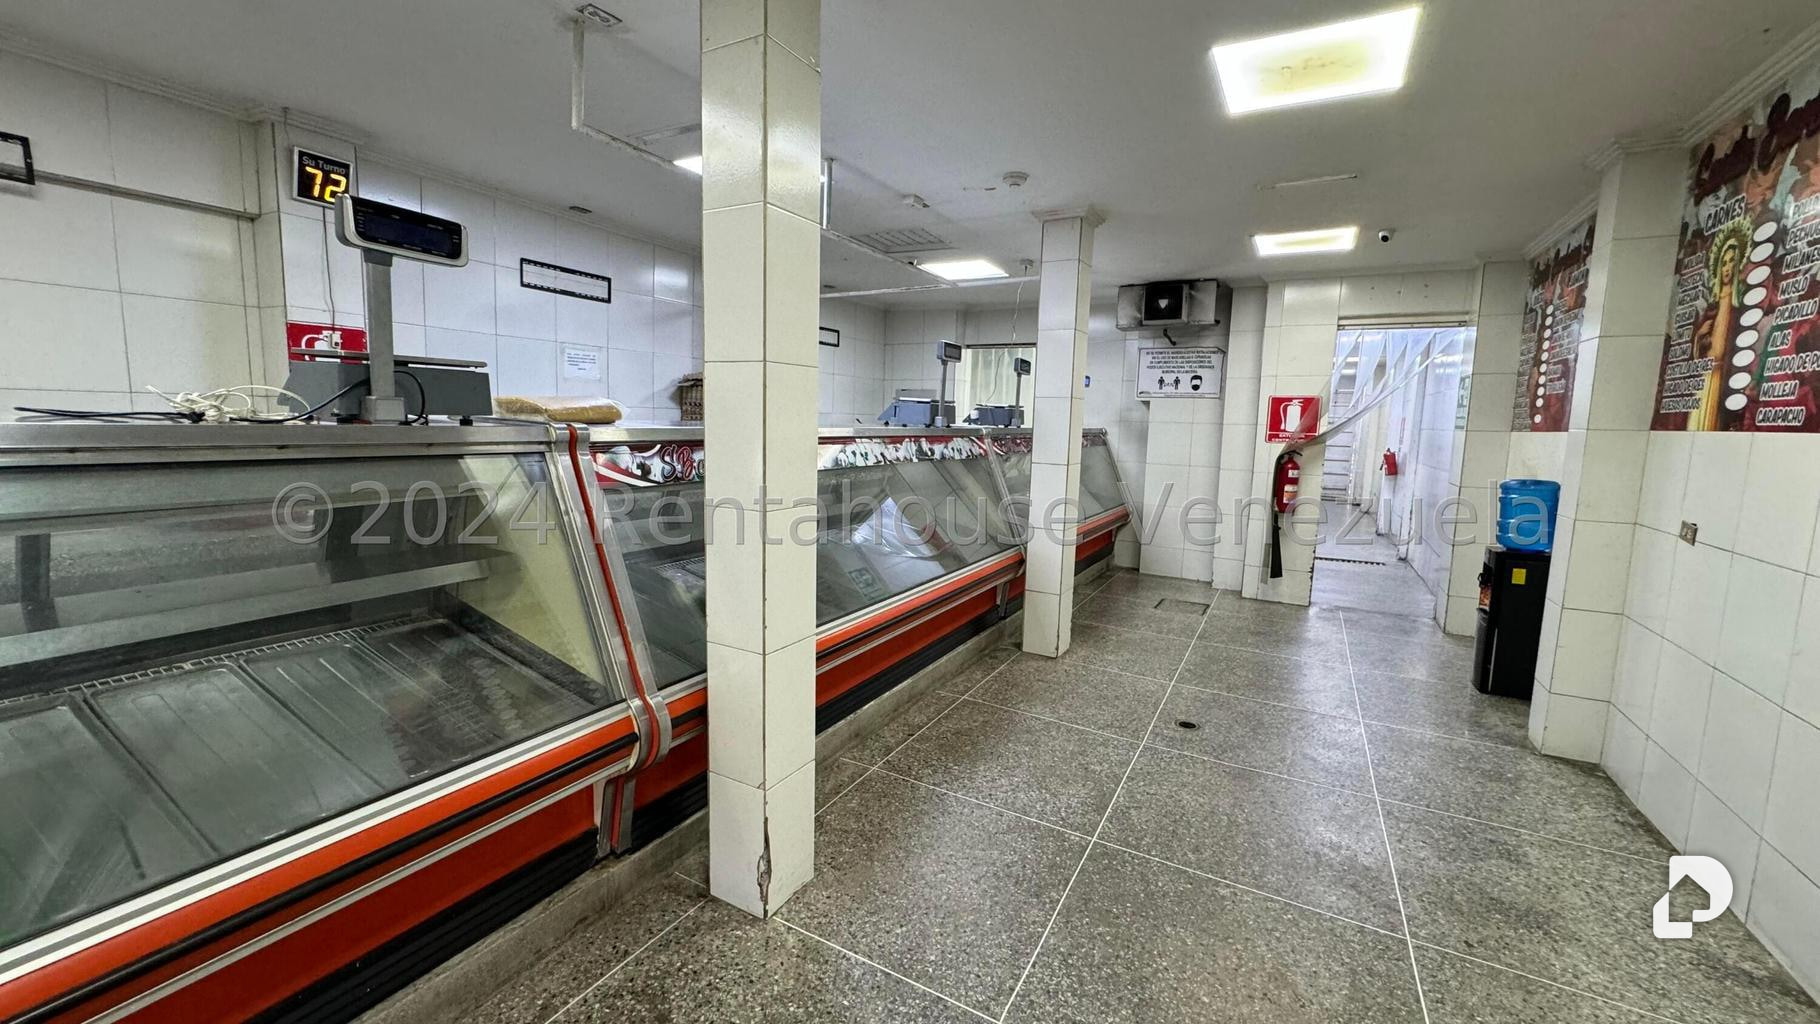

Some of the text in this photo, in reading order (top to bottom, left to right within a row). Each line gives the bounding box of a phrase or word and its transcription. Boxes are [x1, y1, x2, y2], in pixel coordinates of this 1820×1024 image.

[302, 155, 346, 175] Su Turno
[305, 166, 347, 203] 72
[1704, 194, 1746, 235] CARNES
[1778, 275, 1810, 300] MUSLO
[1773, 299, 1818, 325] PICADILLO
[1768, 329, 1792, 350] ALAS
[1764, 354, 1796, 376] HIGADO
[1797, 352, 1811, 373] DE
[1759, 380, 1799, 401] MOLLEJA
[1756, 406, 1805, 425] CARAPACHO
